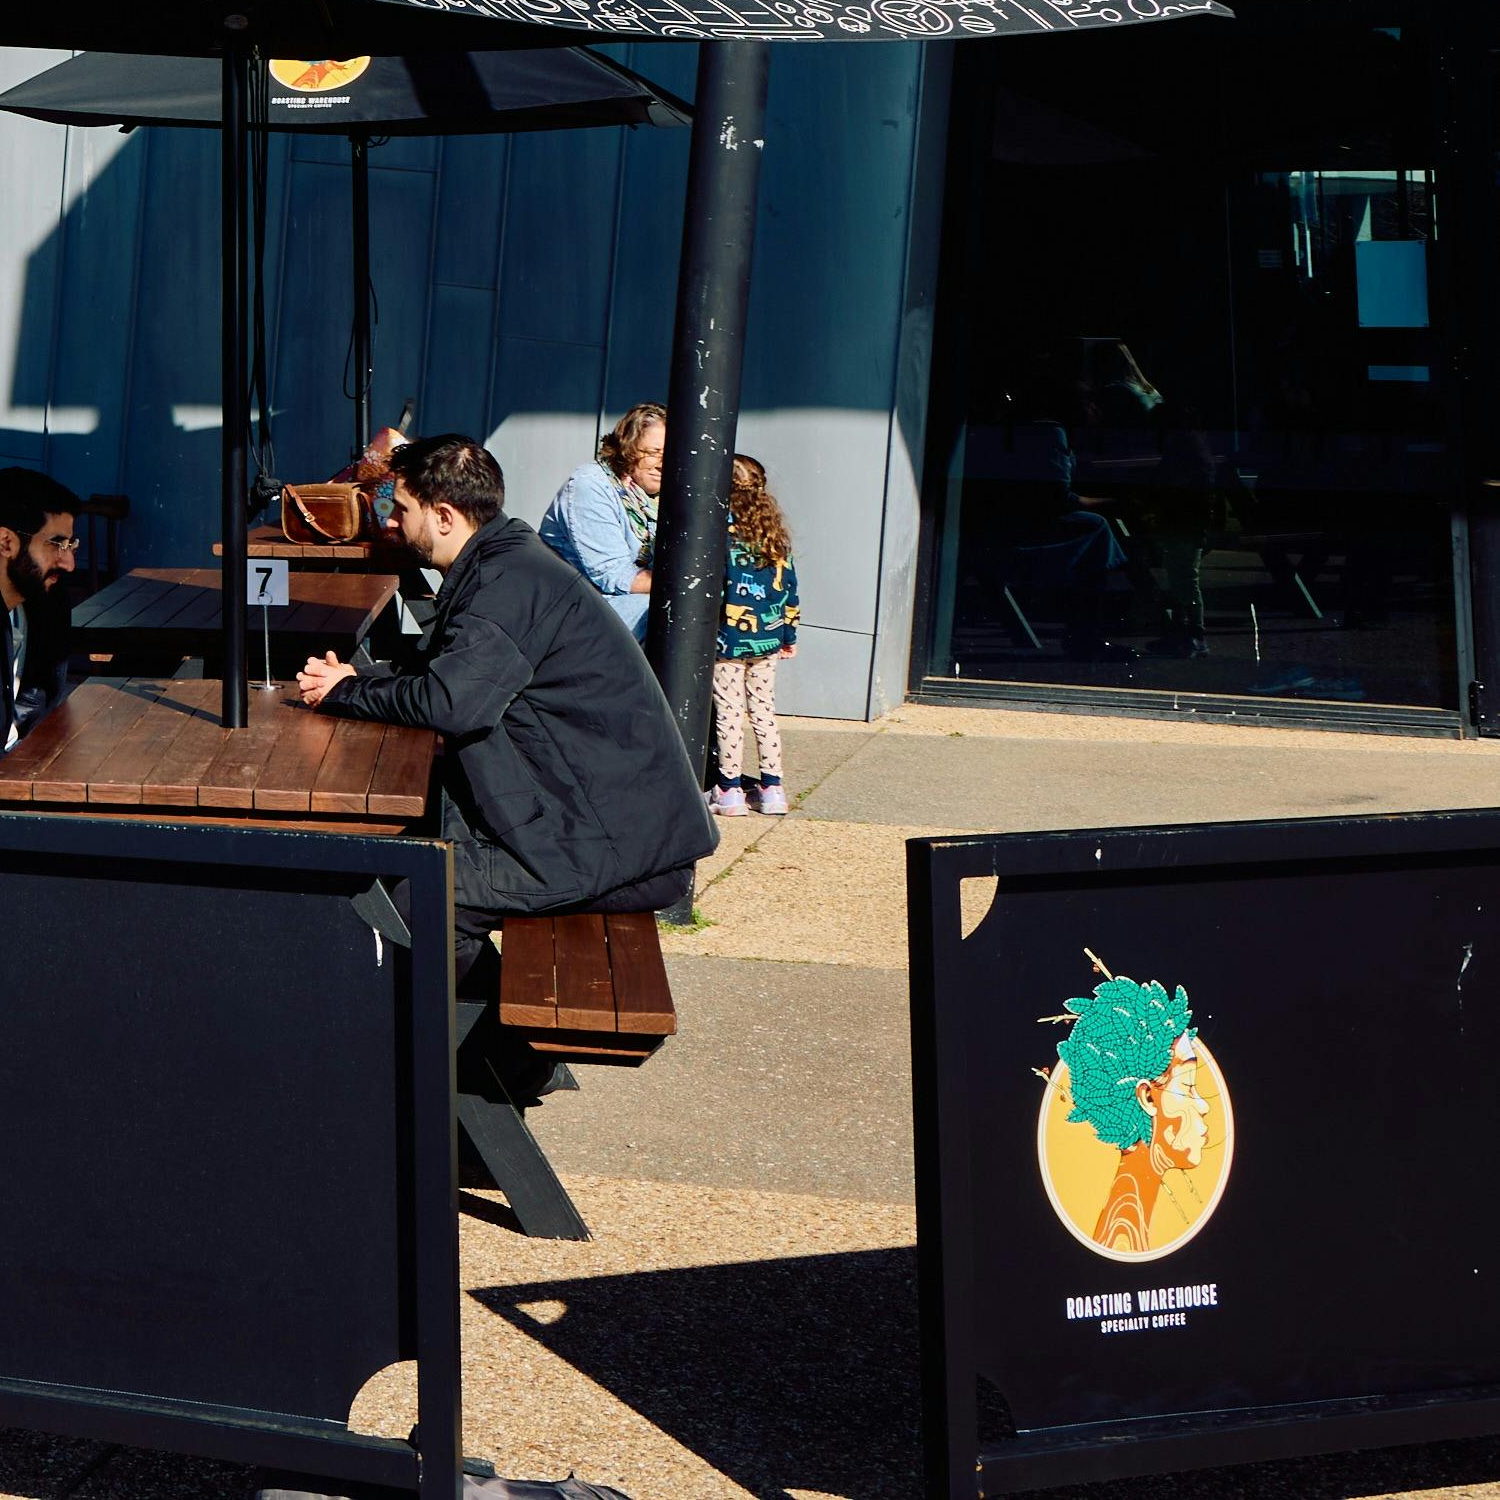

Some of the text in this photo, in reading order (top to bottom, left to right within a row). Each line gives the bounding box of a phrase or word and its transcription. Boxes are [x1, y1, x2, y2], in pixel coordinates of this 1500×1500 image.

[255, 567, 273, 598] 7
[1066, 1283, 1218, 1320] ROASTING WAREHOUSE
[1100, 1312, 1187, 1334] SPECIALTY COFFEE
